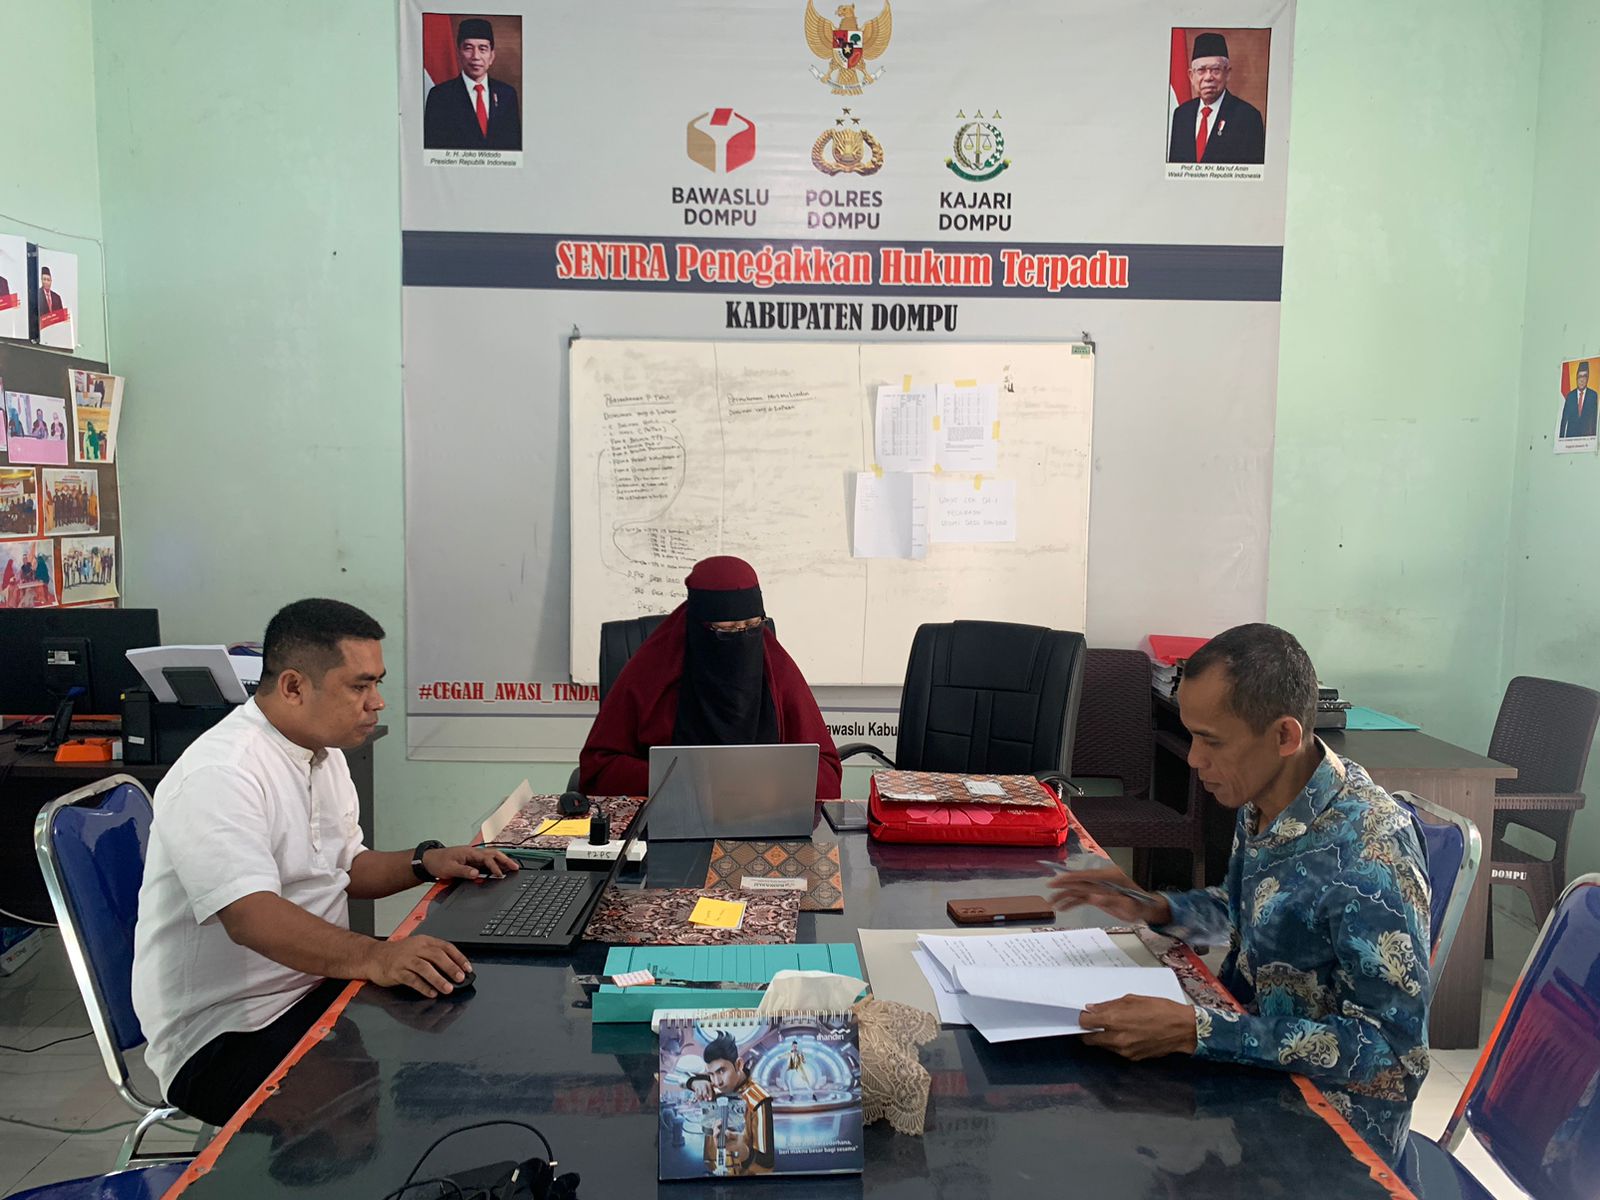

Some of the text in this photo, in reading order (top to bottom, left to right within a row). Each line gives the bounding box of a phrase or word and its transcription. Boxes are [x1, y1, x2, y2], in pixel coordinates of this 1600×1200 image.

[459, 159, 486, 167] Republik
[672, 187, 769, 207] BAWASLU
[806, 189, 883, 209] POLRES
[939, 191, 1012, 210] KAJARI
[684, 208, 757, 227] DOMPU
[807, 211, 880, 230] DOMPU
[939, 213, 1012, 232] DOMPU
[556, 242, 1129, 292] SENTRA Penegakkan Hukum Terpadu
[727, 301, 959, 332] KABUPATEN DOMPU
[1491, 869, 1527, 881] DOMPU
